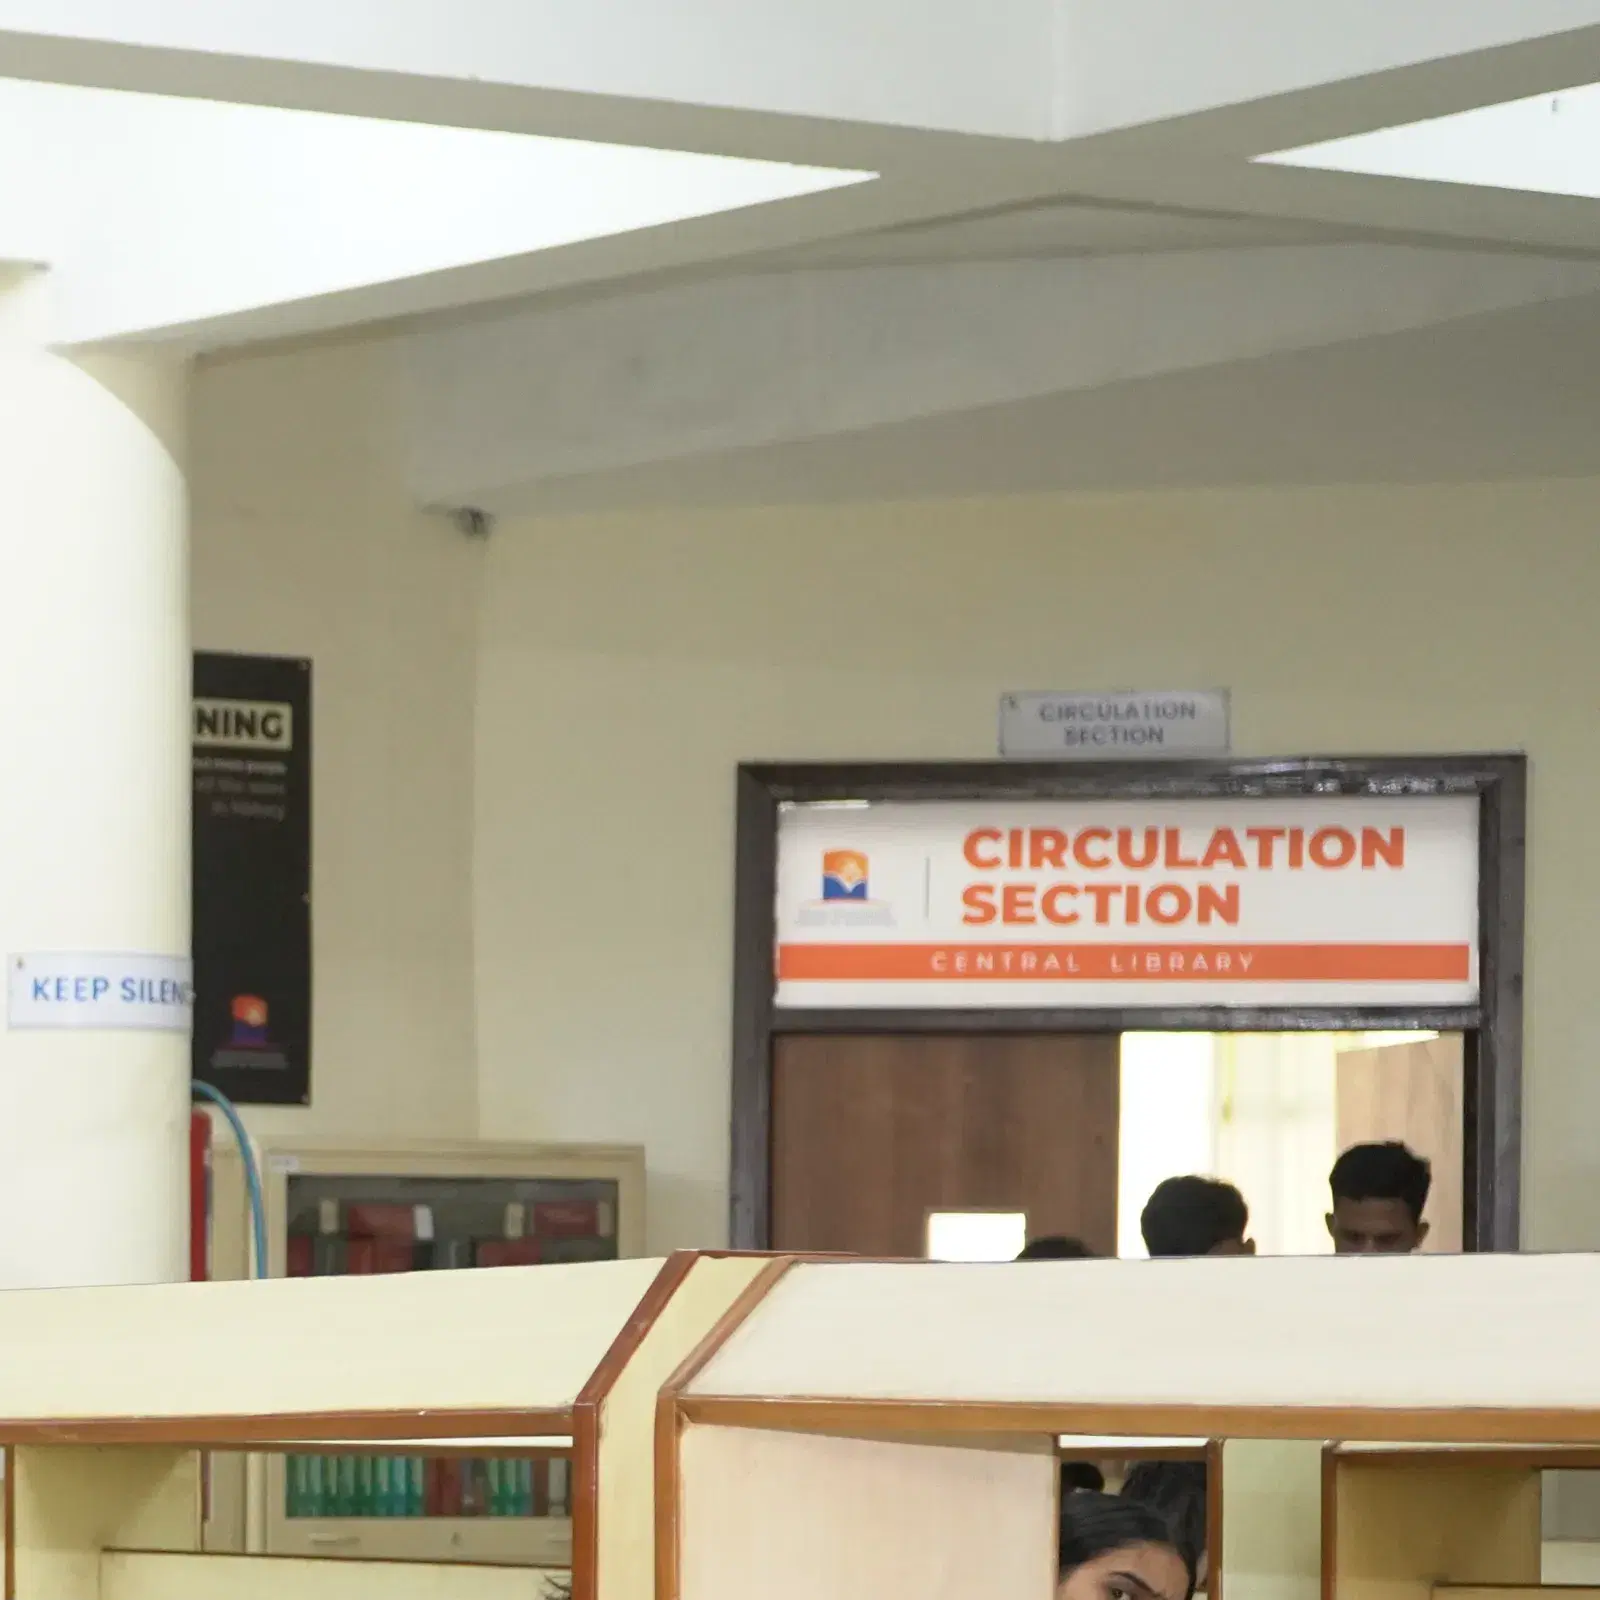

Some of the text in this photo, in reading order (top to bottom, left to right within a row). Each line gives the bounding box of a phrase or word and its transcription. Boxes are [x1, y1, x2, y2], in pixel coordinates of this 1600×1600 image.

[195, 708, 283, 739] NING
[1039, 701, 1196, 722] CIRCULATION
[1064, 725, 1164, 746] SECTION
[961, 825, 1406, 871] CIRCULATION
[961, 883, 1241, 927] SECTION
[930, 951, 1257, 974] CENTRAL LIBRARY
[32, 976, 110, 1002] KEEP
